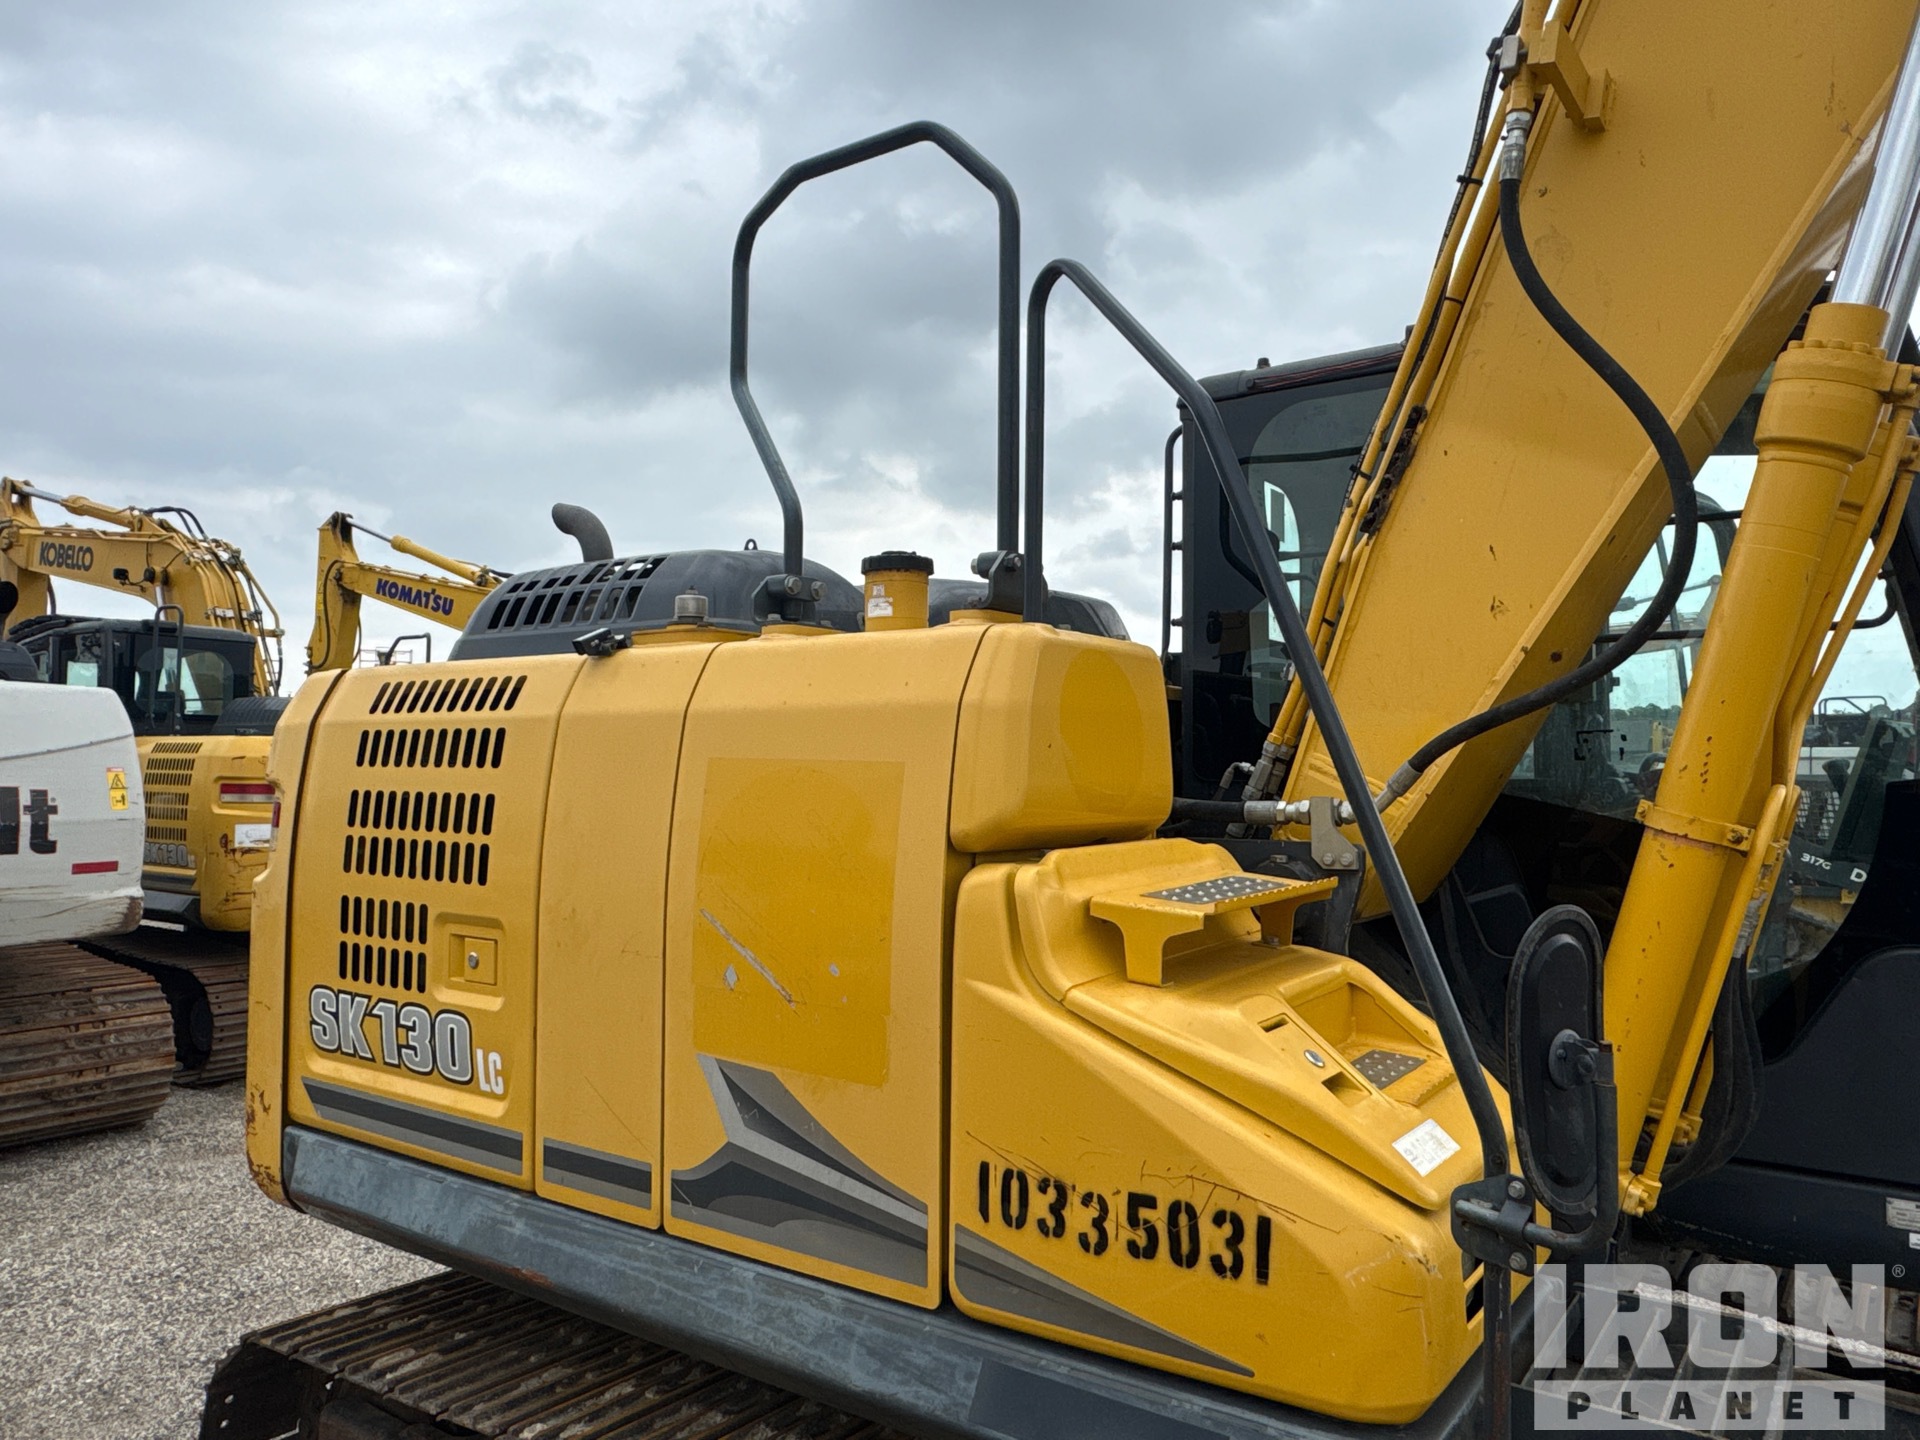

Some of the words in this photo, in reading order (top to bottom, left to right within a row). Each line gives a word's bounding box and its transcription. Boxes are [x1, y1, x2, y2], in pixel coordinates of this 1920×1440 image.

[39, 541, 94, 572] KOBELCO
[375, 578, 454, 616] KOMATSU
[1800, 852, 1832, 870] 317G
[309, 984, 474, 1086] SK130
[475, 1047, 505, 1096] LC
[978, 1160, 1272, 1286] 10335031
